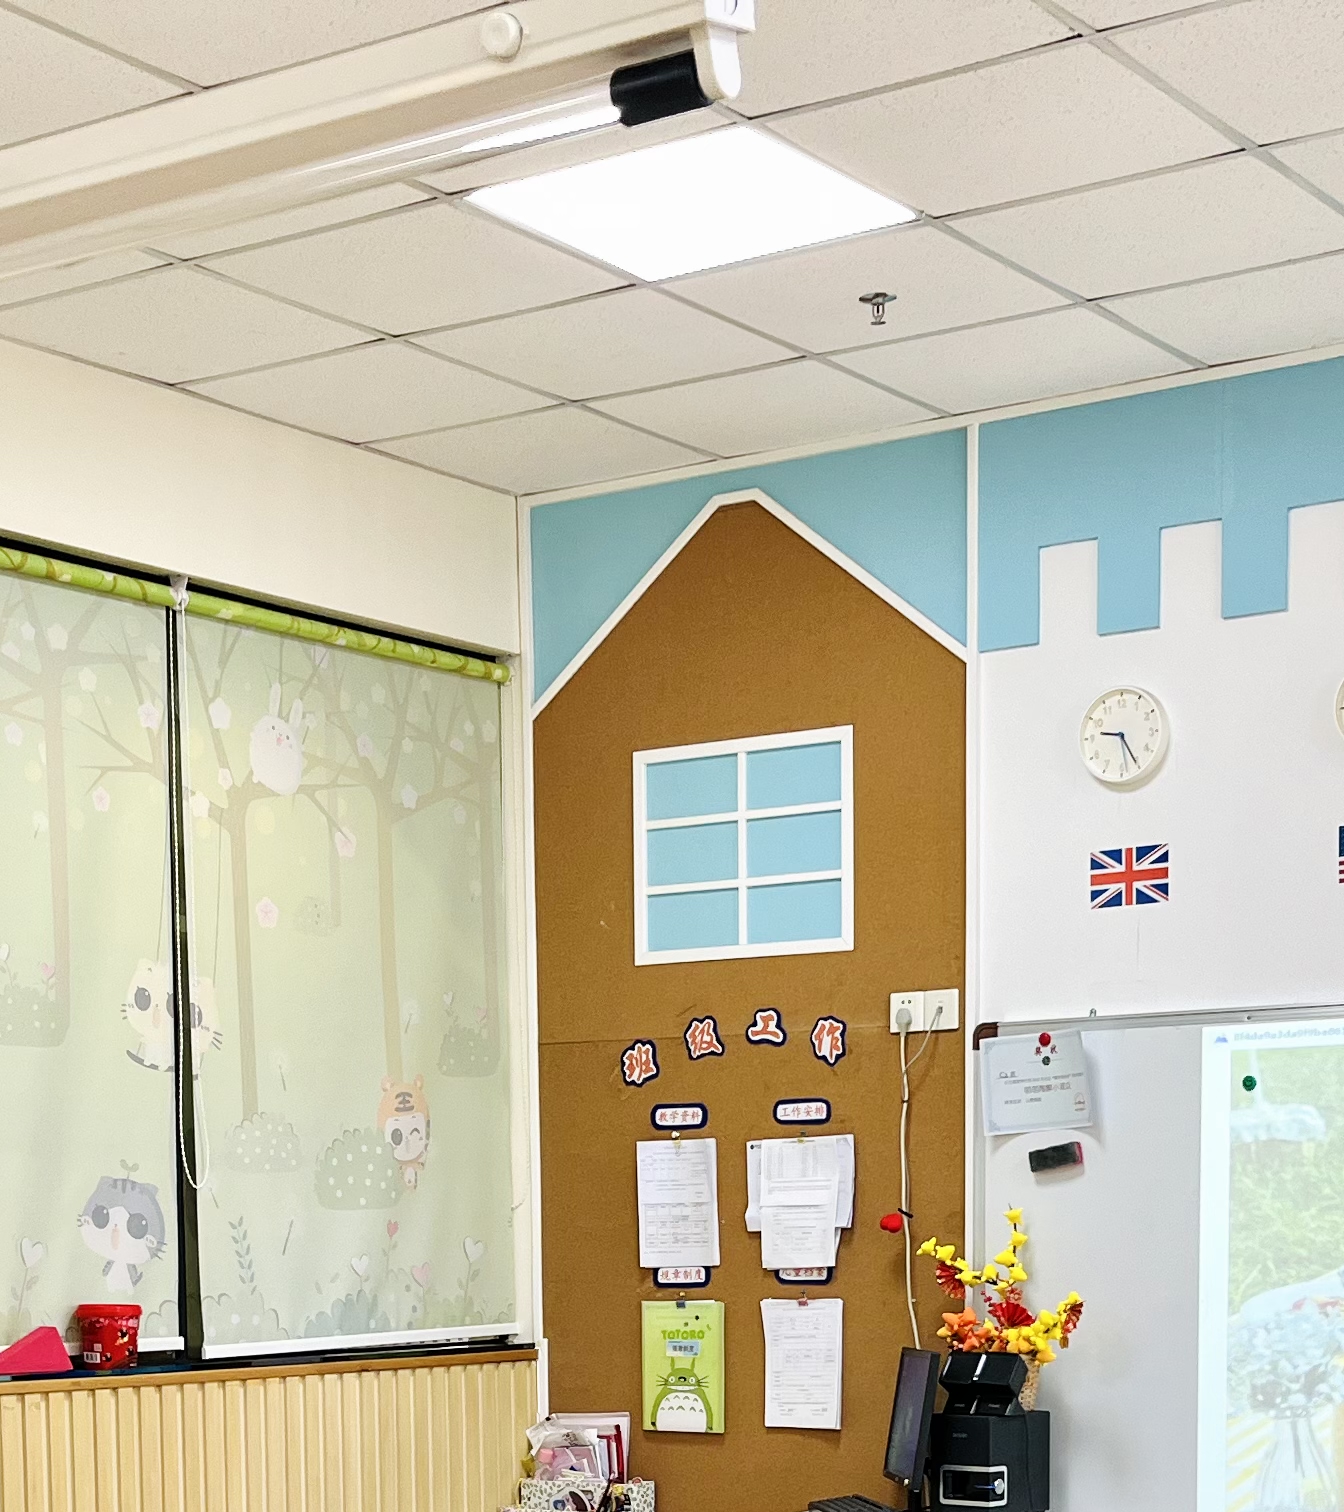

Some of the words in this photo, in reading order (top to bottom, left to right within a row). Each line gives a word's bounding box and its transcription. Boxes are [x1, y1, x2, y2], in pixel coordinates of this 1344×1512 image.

[624, 1013, 843, 1082] 班级工作
[657, 1109, 701, 1123] 教学资料
[779, 1104, 824, 1118] 工作安排
[659, 1268, 703, 1281] 规章制度
[661, 1329, 705, 1340] TOTORO
